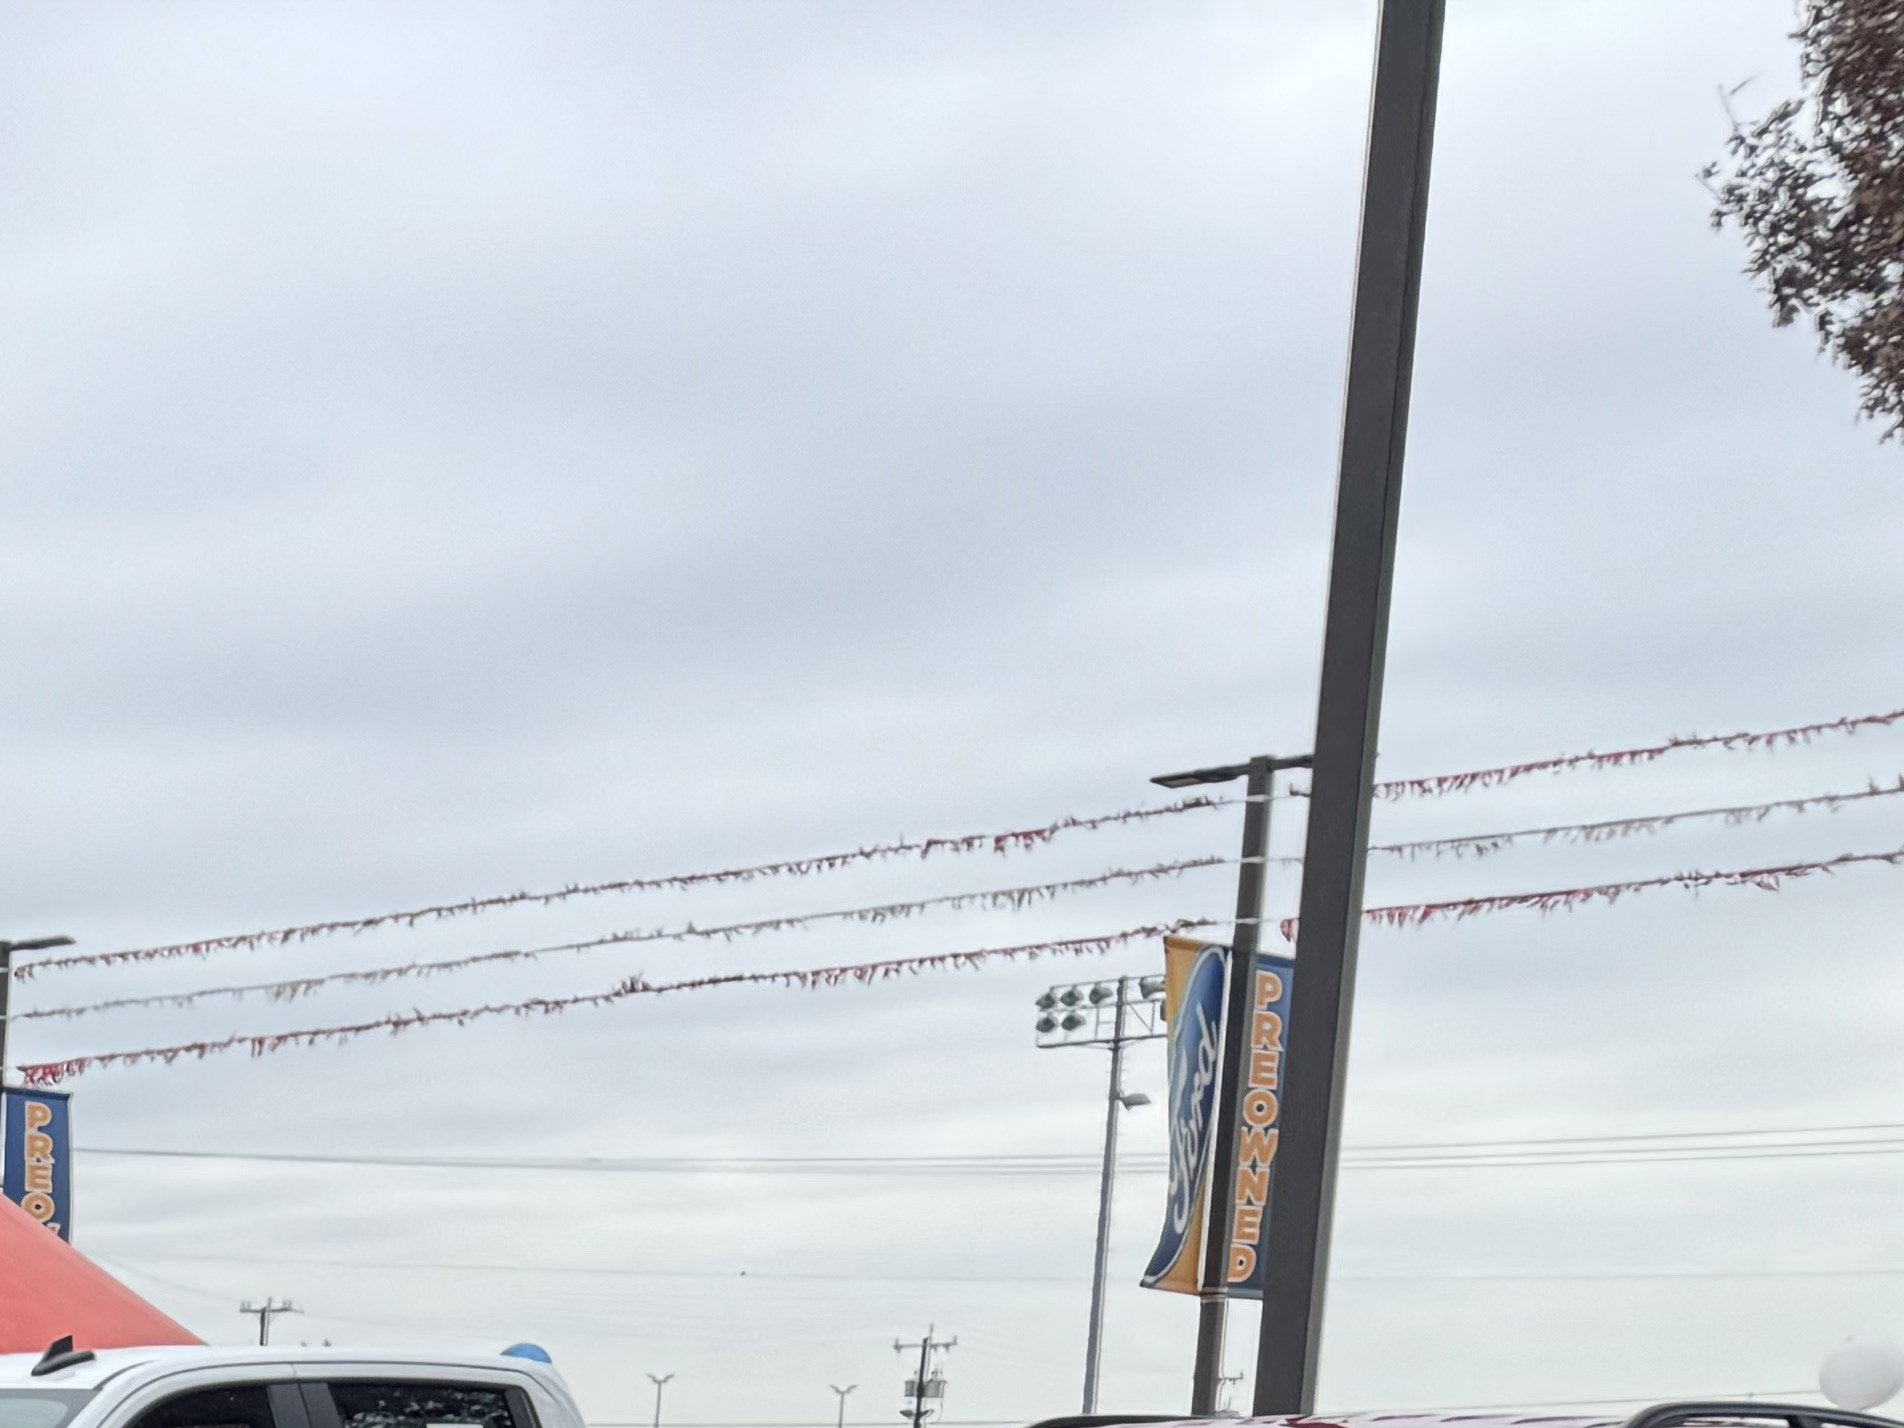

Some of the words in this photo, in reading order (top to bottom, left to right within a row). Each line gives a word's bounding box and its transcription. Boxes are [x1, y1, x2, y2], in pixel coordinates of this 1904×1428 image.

[20, 1100, 62, 1236] PREO
[1171, 1003, 1218, 1235] Ford
[1226, 969, 1284, 1284] PREOWNED
